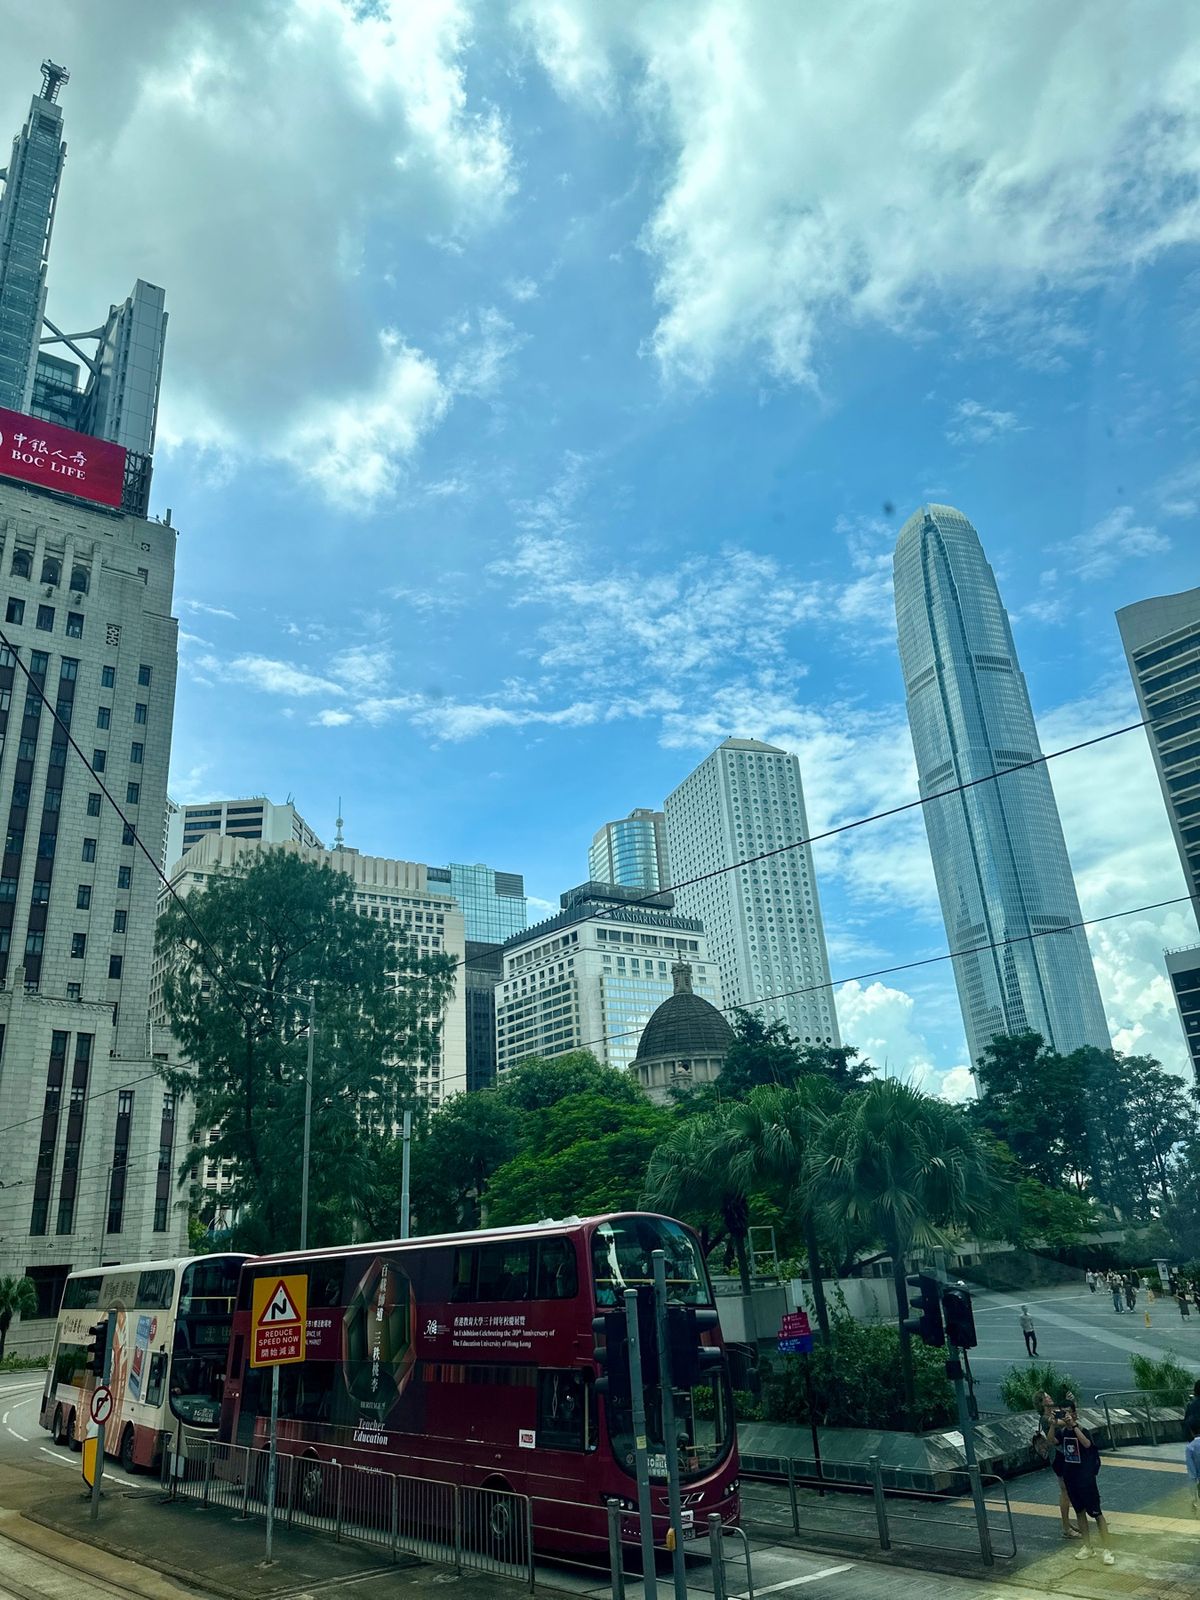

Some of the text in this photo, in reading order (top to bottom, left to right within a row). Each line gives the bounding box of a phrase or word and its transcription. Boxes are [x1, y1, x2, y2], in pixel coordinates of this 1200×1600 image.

[11, 450, 87, 480] BOC LIFE
[612, 911, 697, 930] MANDARIN ORIENTAL
[265, 1329, 293, 1338] REDUCE
[522, 1329, 548, 1338] Anniversary
[549, 1329, 555, 1337] of
[258, 1338, 281, 1346] SPEED
[282, 1336, 299, 1344] NOW
[481, 1340, 501, 1348] University
[507, 1340, 519, 1348] Hong
[519, 1340, 532, 1348] Kong
[261, 1345, 296, 1358] 開始減速
[358, 1418, 386, 1431] Teacher
[353, 1430, 389, 1446] Education
